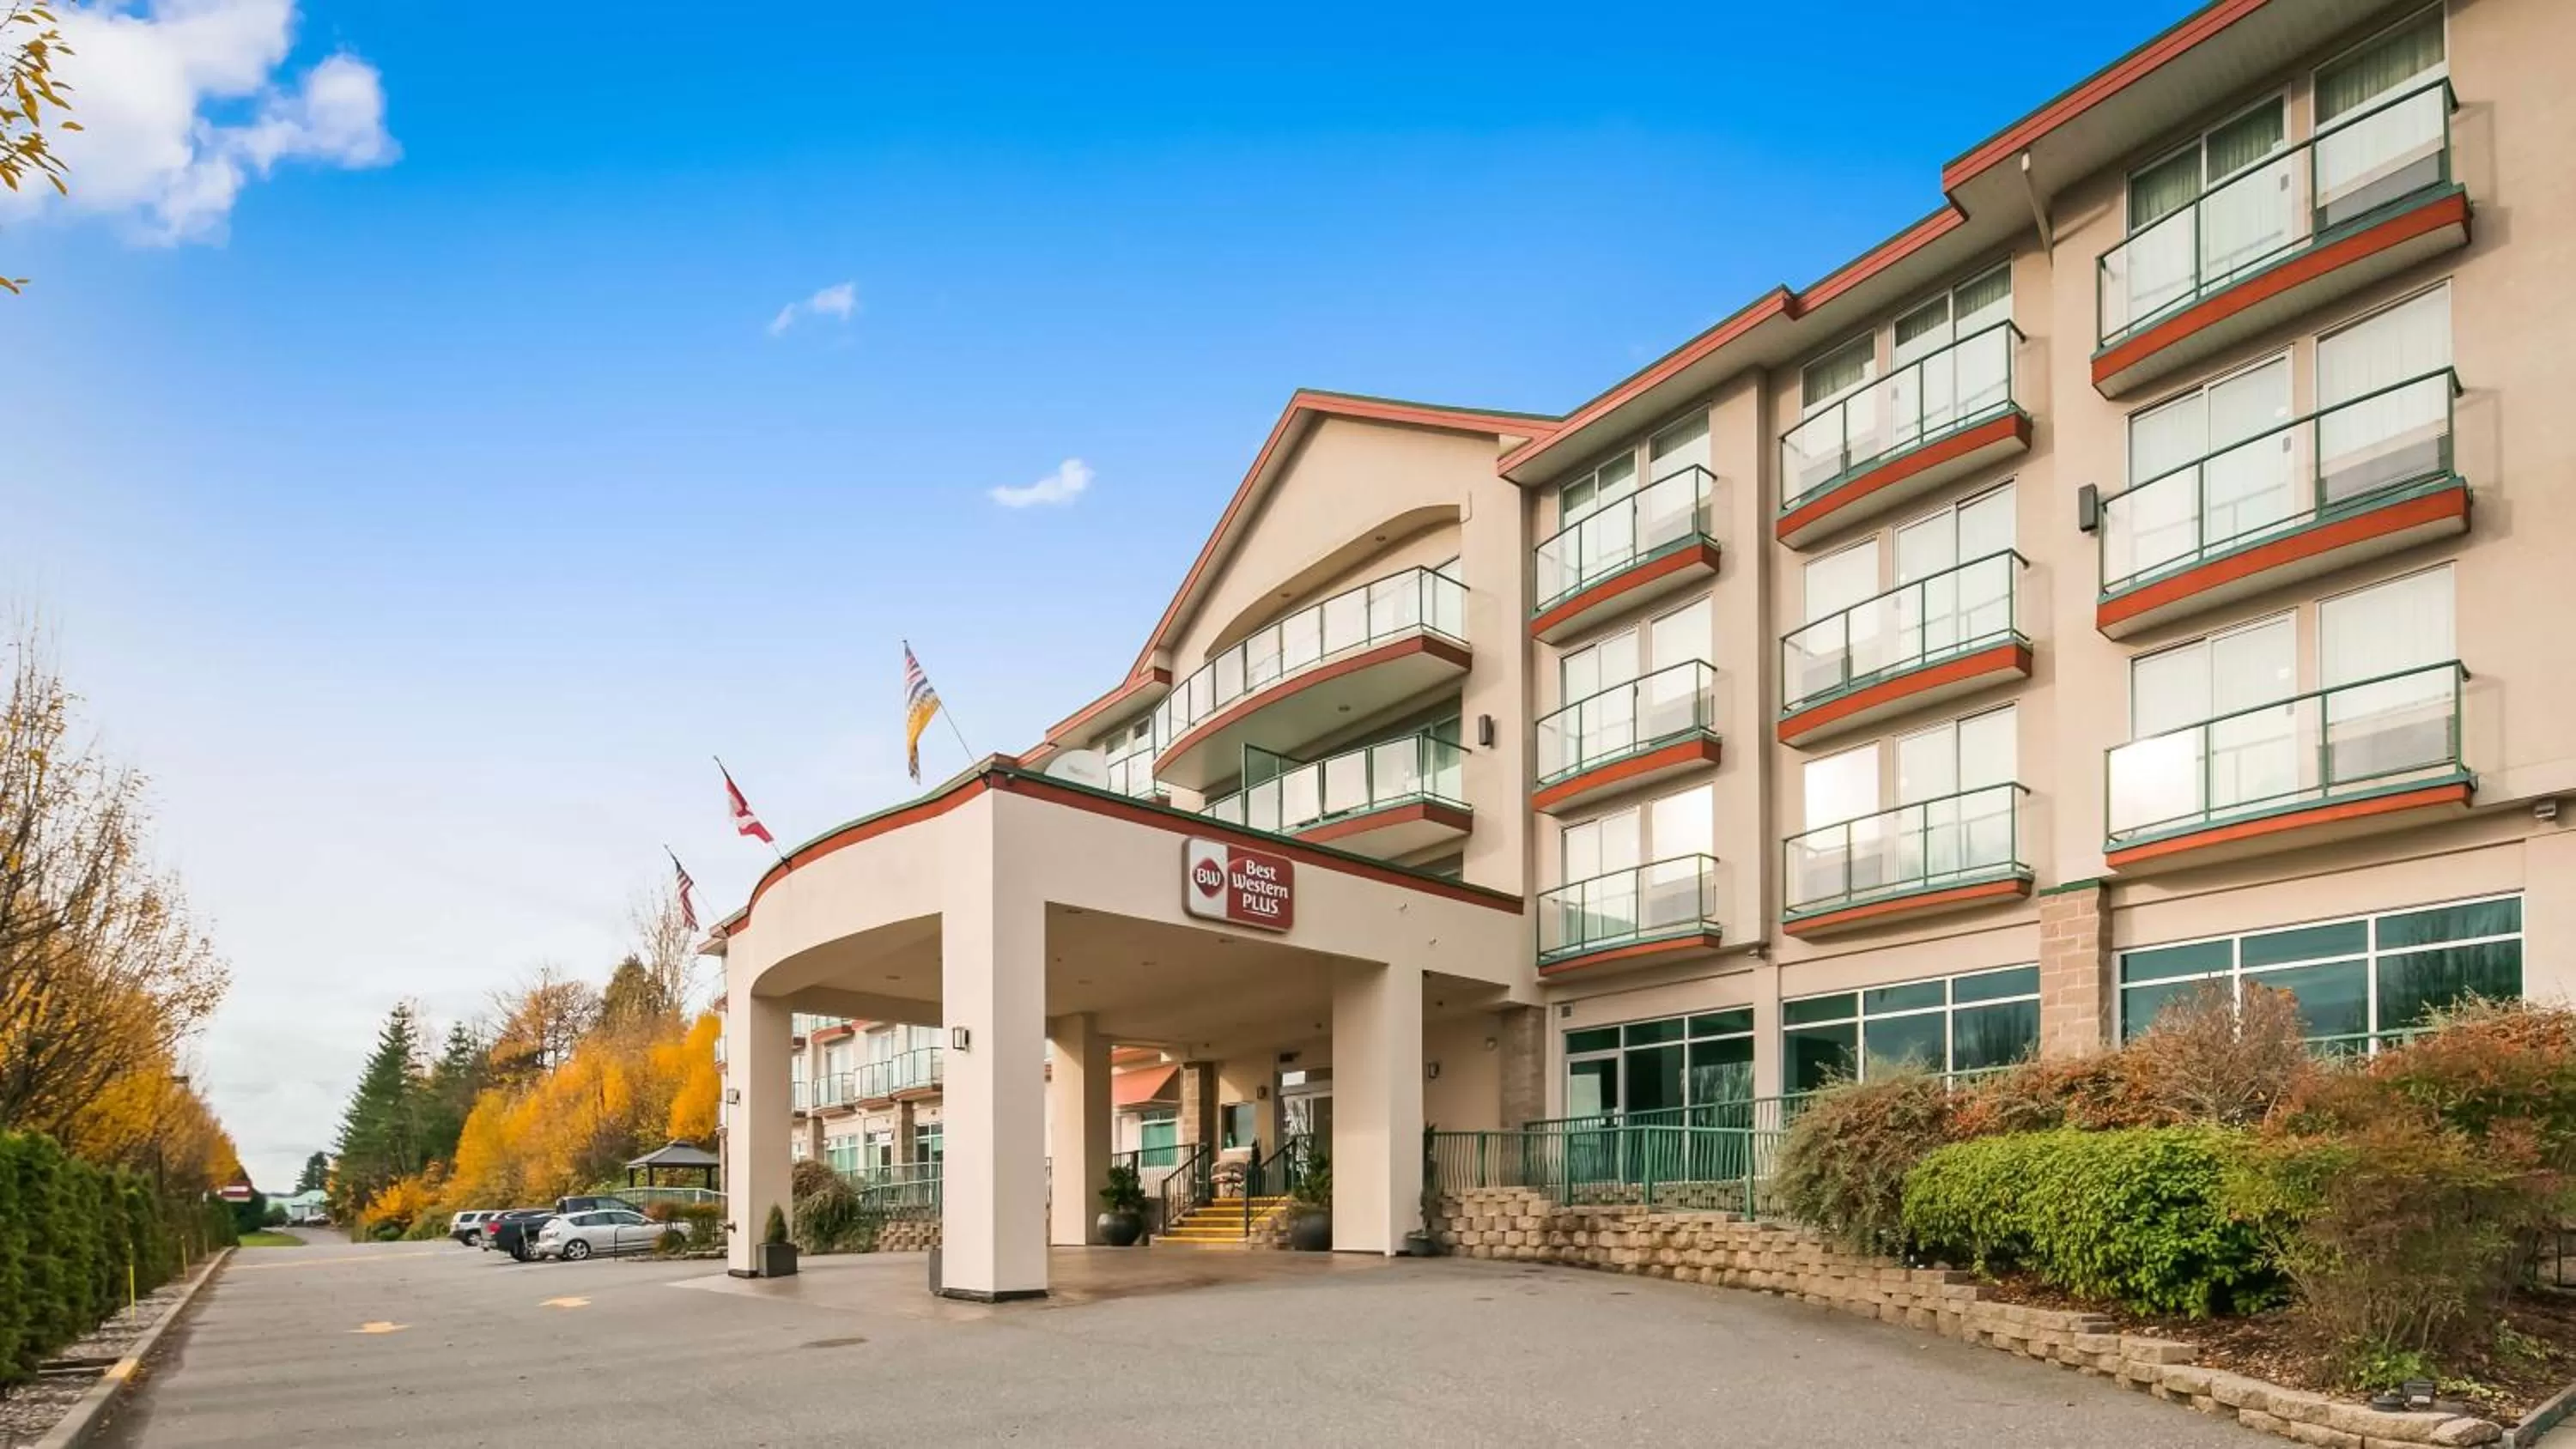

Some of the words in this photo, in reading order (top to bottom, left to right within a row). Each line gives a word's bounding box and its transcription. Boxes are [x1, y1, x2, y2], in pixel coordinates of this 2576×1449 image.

[1196, 868, 1220, 887] BW
[1246, 859, 1276, 881] Best
[1232, 872, 1288, 899] Western
[1242, 893, 1279, 914] PLUS
